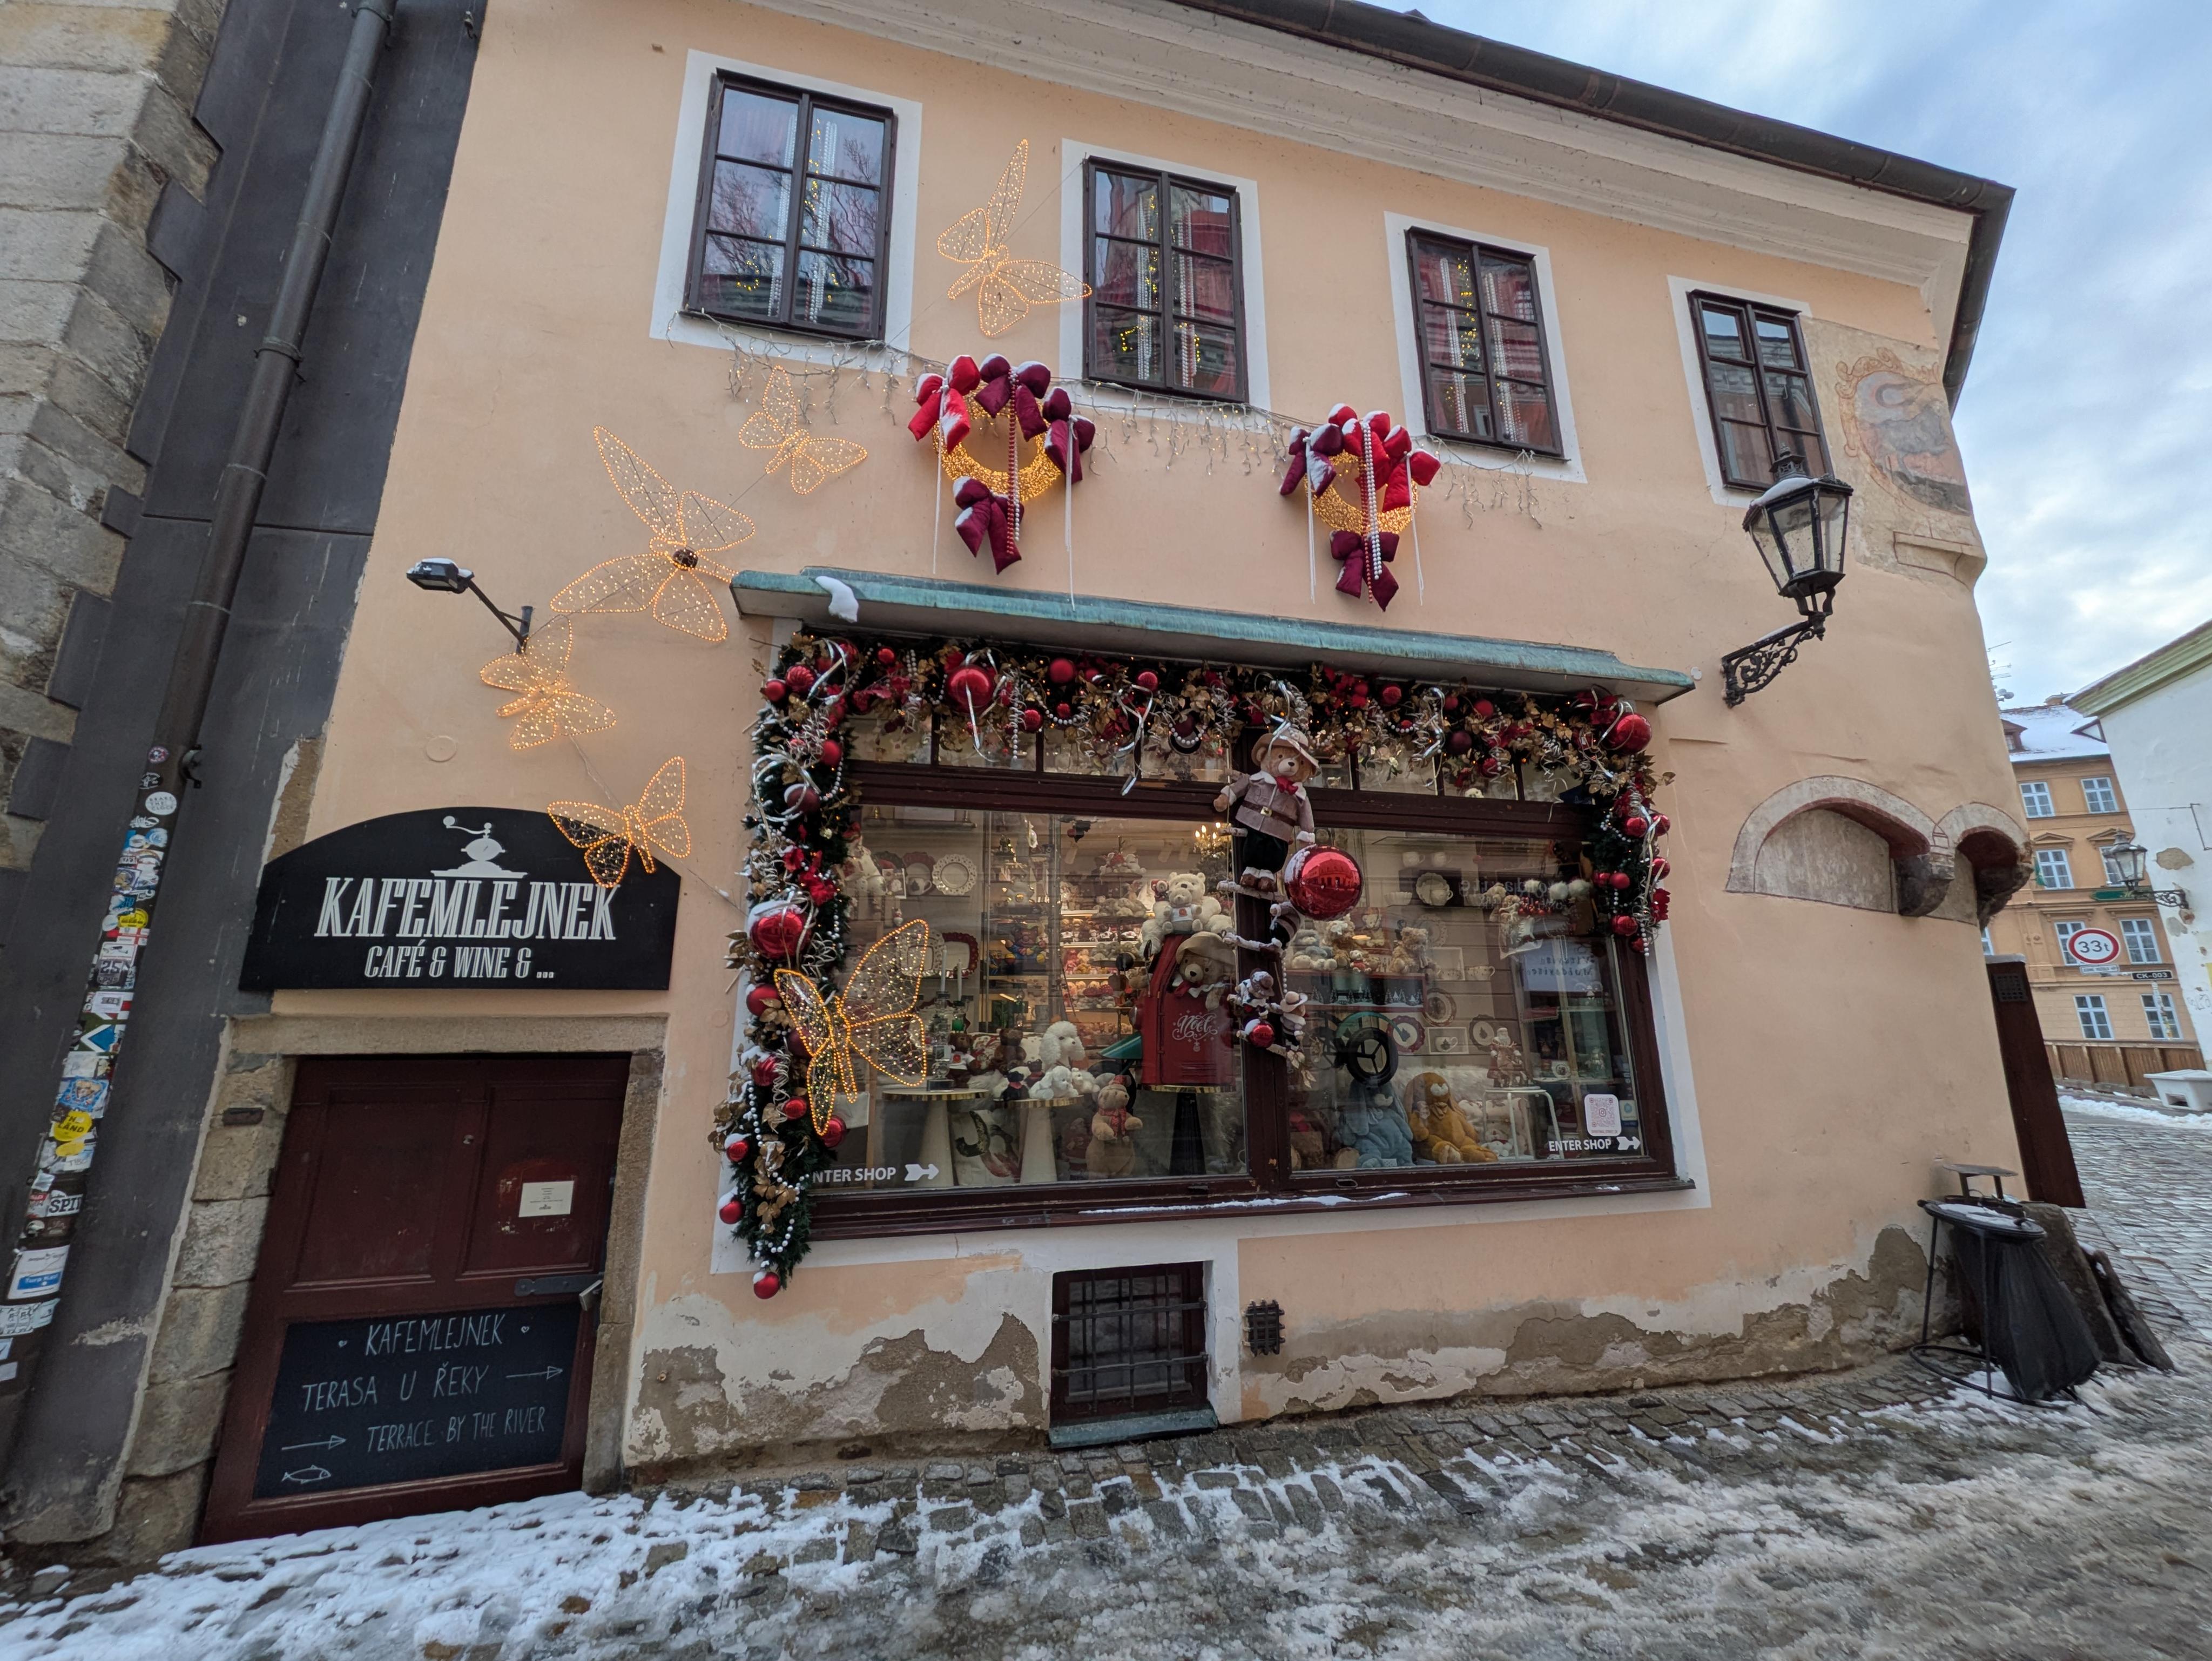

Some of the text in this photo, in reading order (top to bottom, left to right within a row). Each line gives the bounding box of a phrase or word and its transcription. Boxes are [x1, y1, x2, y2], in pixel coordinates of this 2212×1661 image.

[314, 877, 621, 940] KAFEMLEJNEK
[364, 940, 427, 978] CAFÉ
[428, 947, 447, 978] &
[453, 947, 510, 978] WINE
[515, 947, 532, 978] &
[1548, 1138, 1612, 1152] ENTER SHOP
[812, 1166, 896, 1184] NTER SHOP
[364, 1313, 505, 1356] KAFEMLEJNEK
[302, 1361, 489, 1412] TERASA U ŘEKY
[367, 1406, 546, 1452] TERRACE BY THE RIVER
